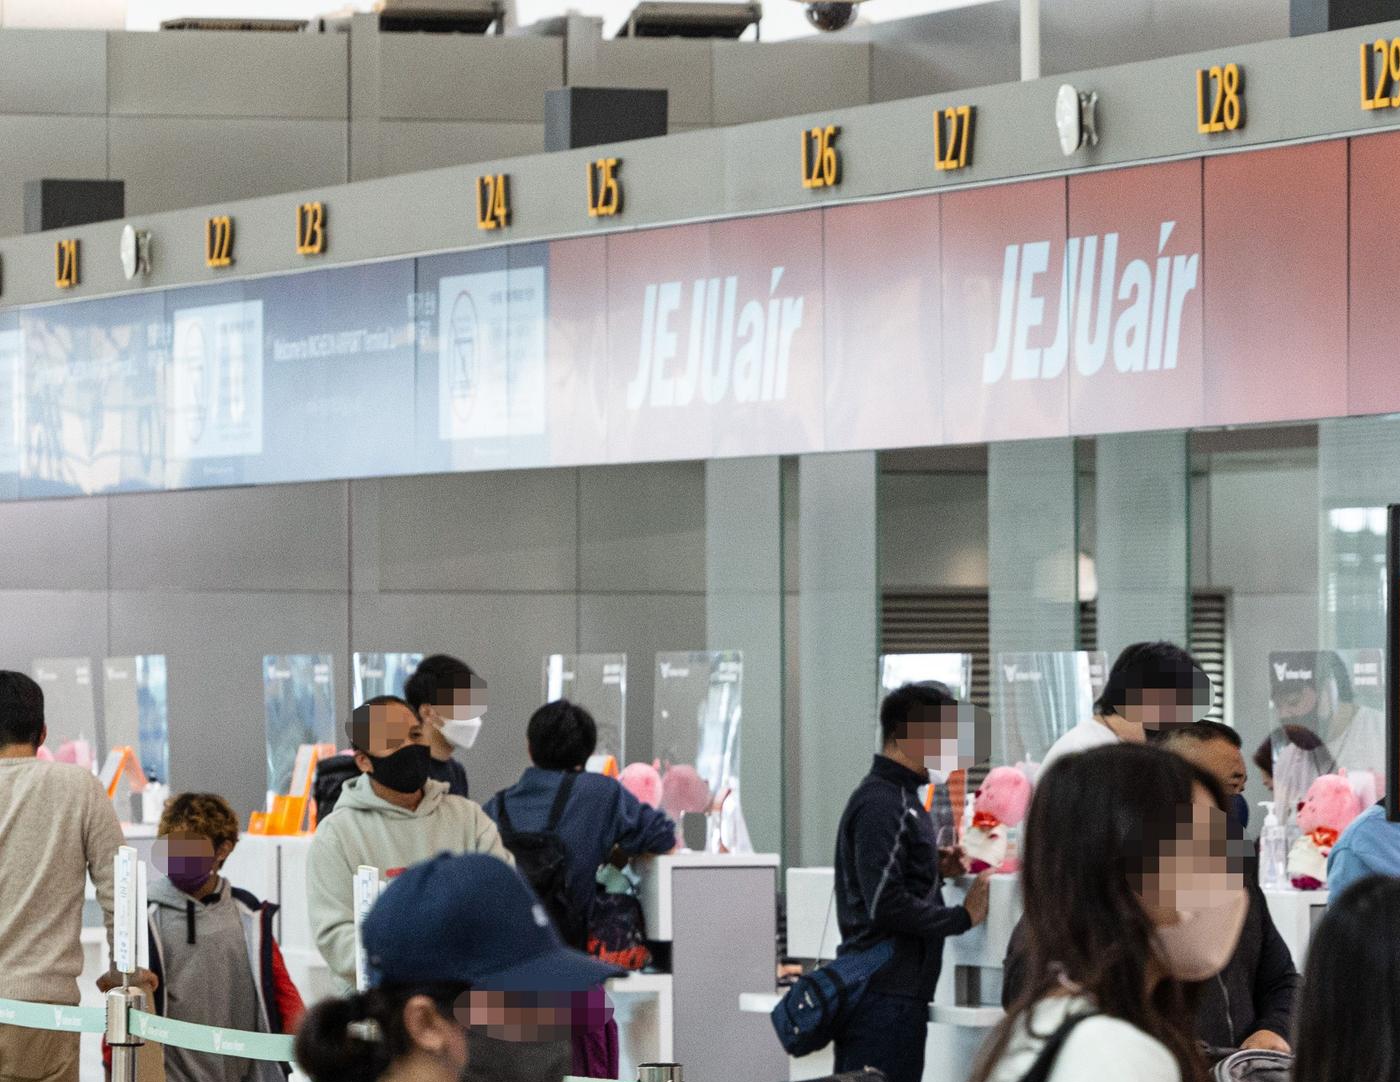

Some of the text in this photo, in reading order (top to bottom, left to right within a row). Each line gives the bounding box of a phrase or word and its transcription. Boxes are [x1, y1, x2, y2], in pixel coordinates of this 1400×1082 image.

[1197, 64, 1240, 133] L28
[802, 126, 837, 188] L26
[934, 106, 971, 170] L27
[477, 174, 508, 230] L24
[587, 159, 619, 217] L25
[206, 217, 232, 267] L22
[296, 203, 323, 254] L23
[56, 240, 78, 287] L21
